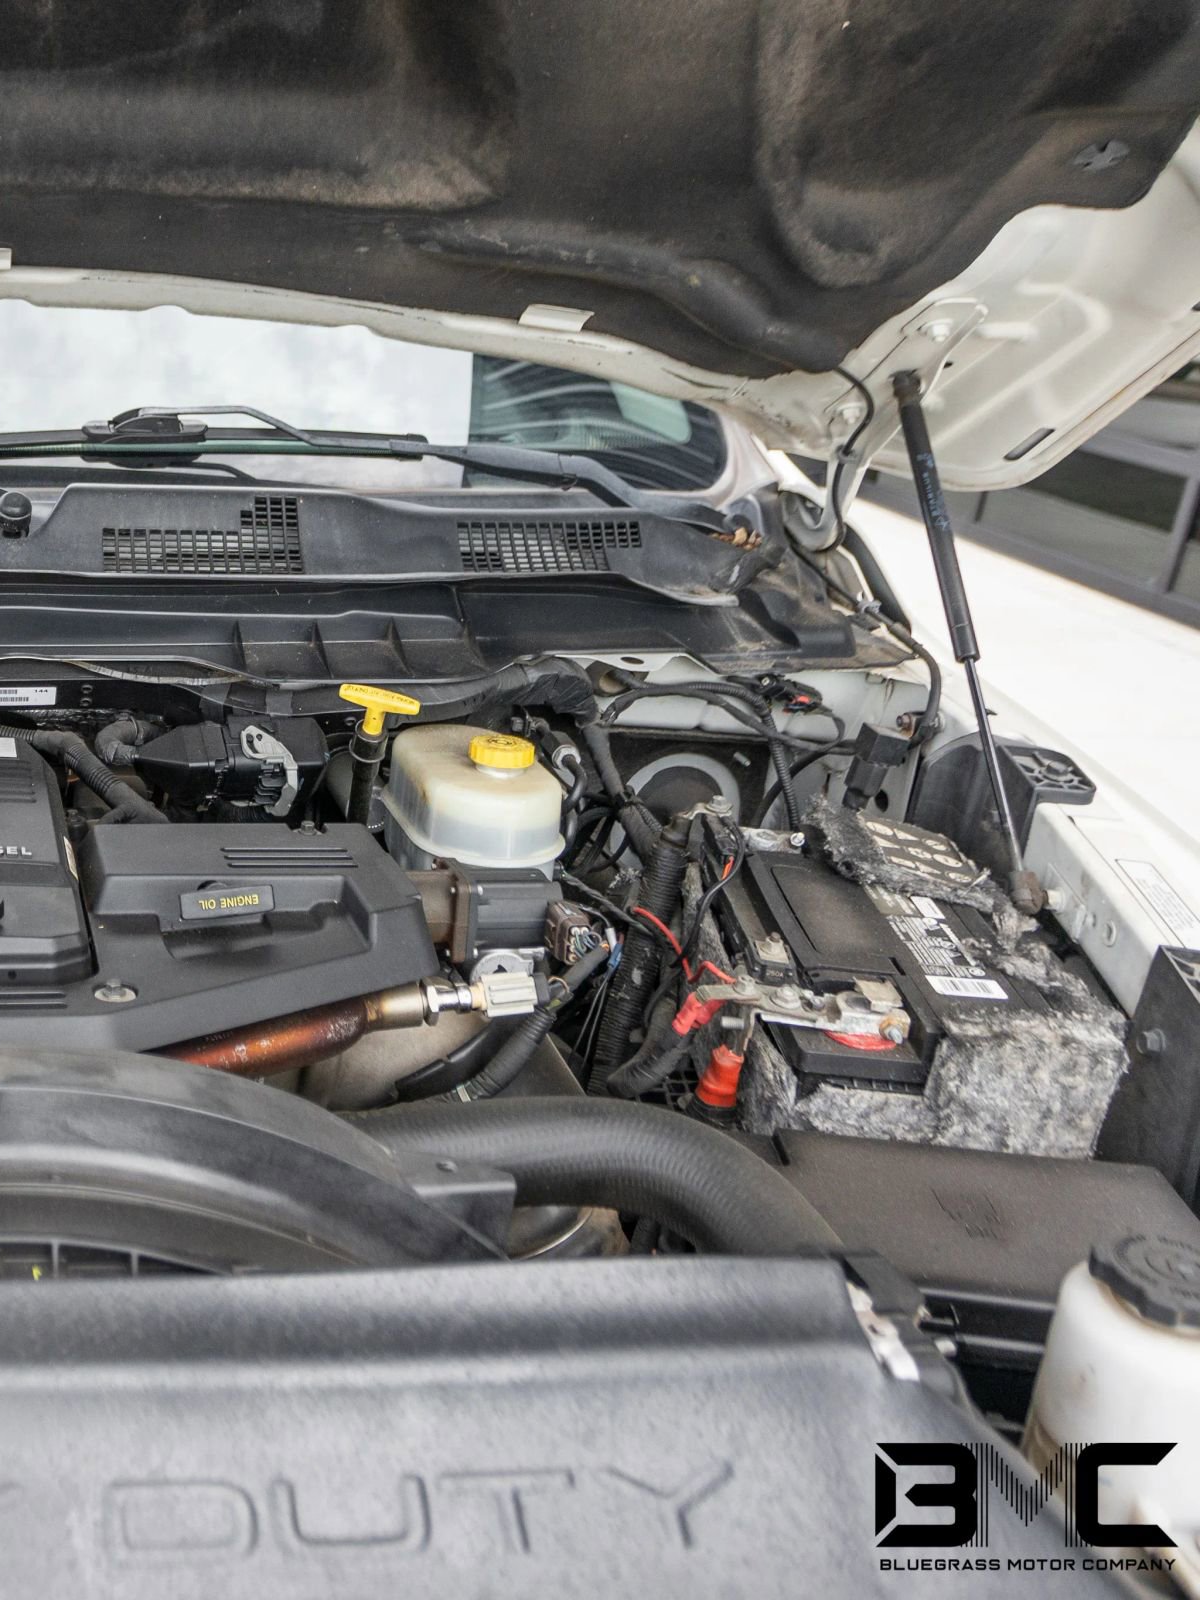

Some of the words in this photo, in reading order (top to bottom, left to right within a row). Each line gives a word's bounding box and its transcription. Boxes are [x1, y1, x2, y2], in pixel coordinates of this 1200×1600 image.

[198, 899, 216, 910] OIL
[220, 894, 259, 909] ENGINE
[102, 1462, 734, 1568] DUTY
